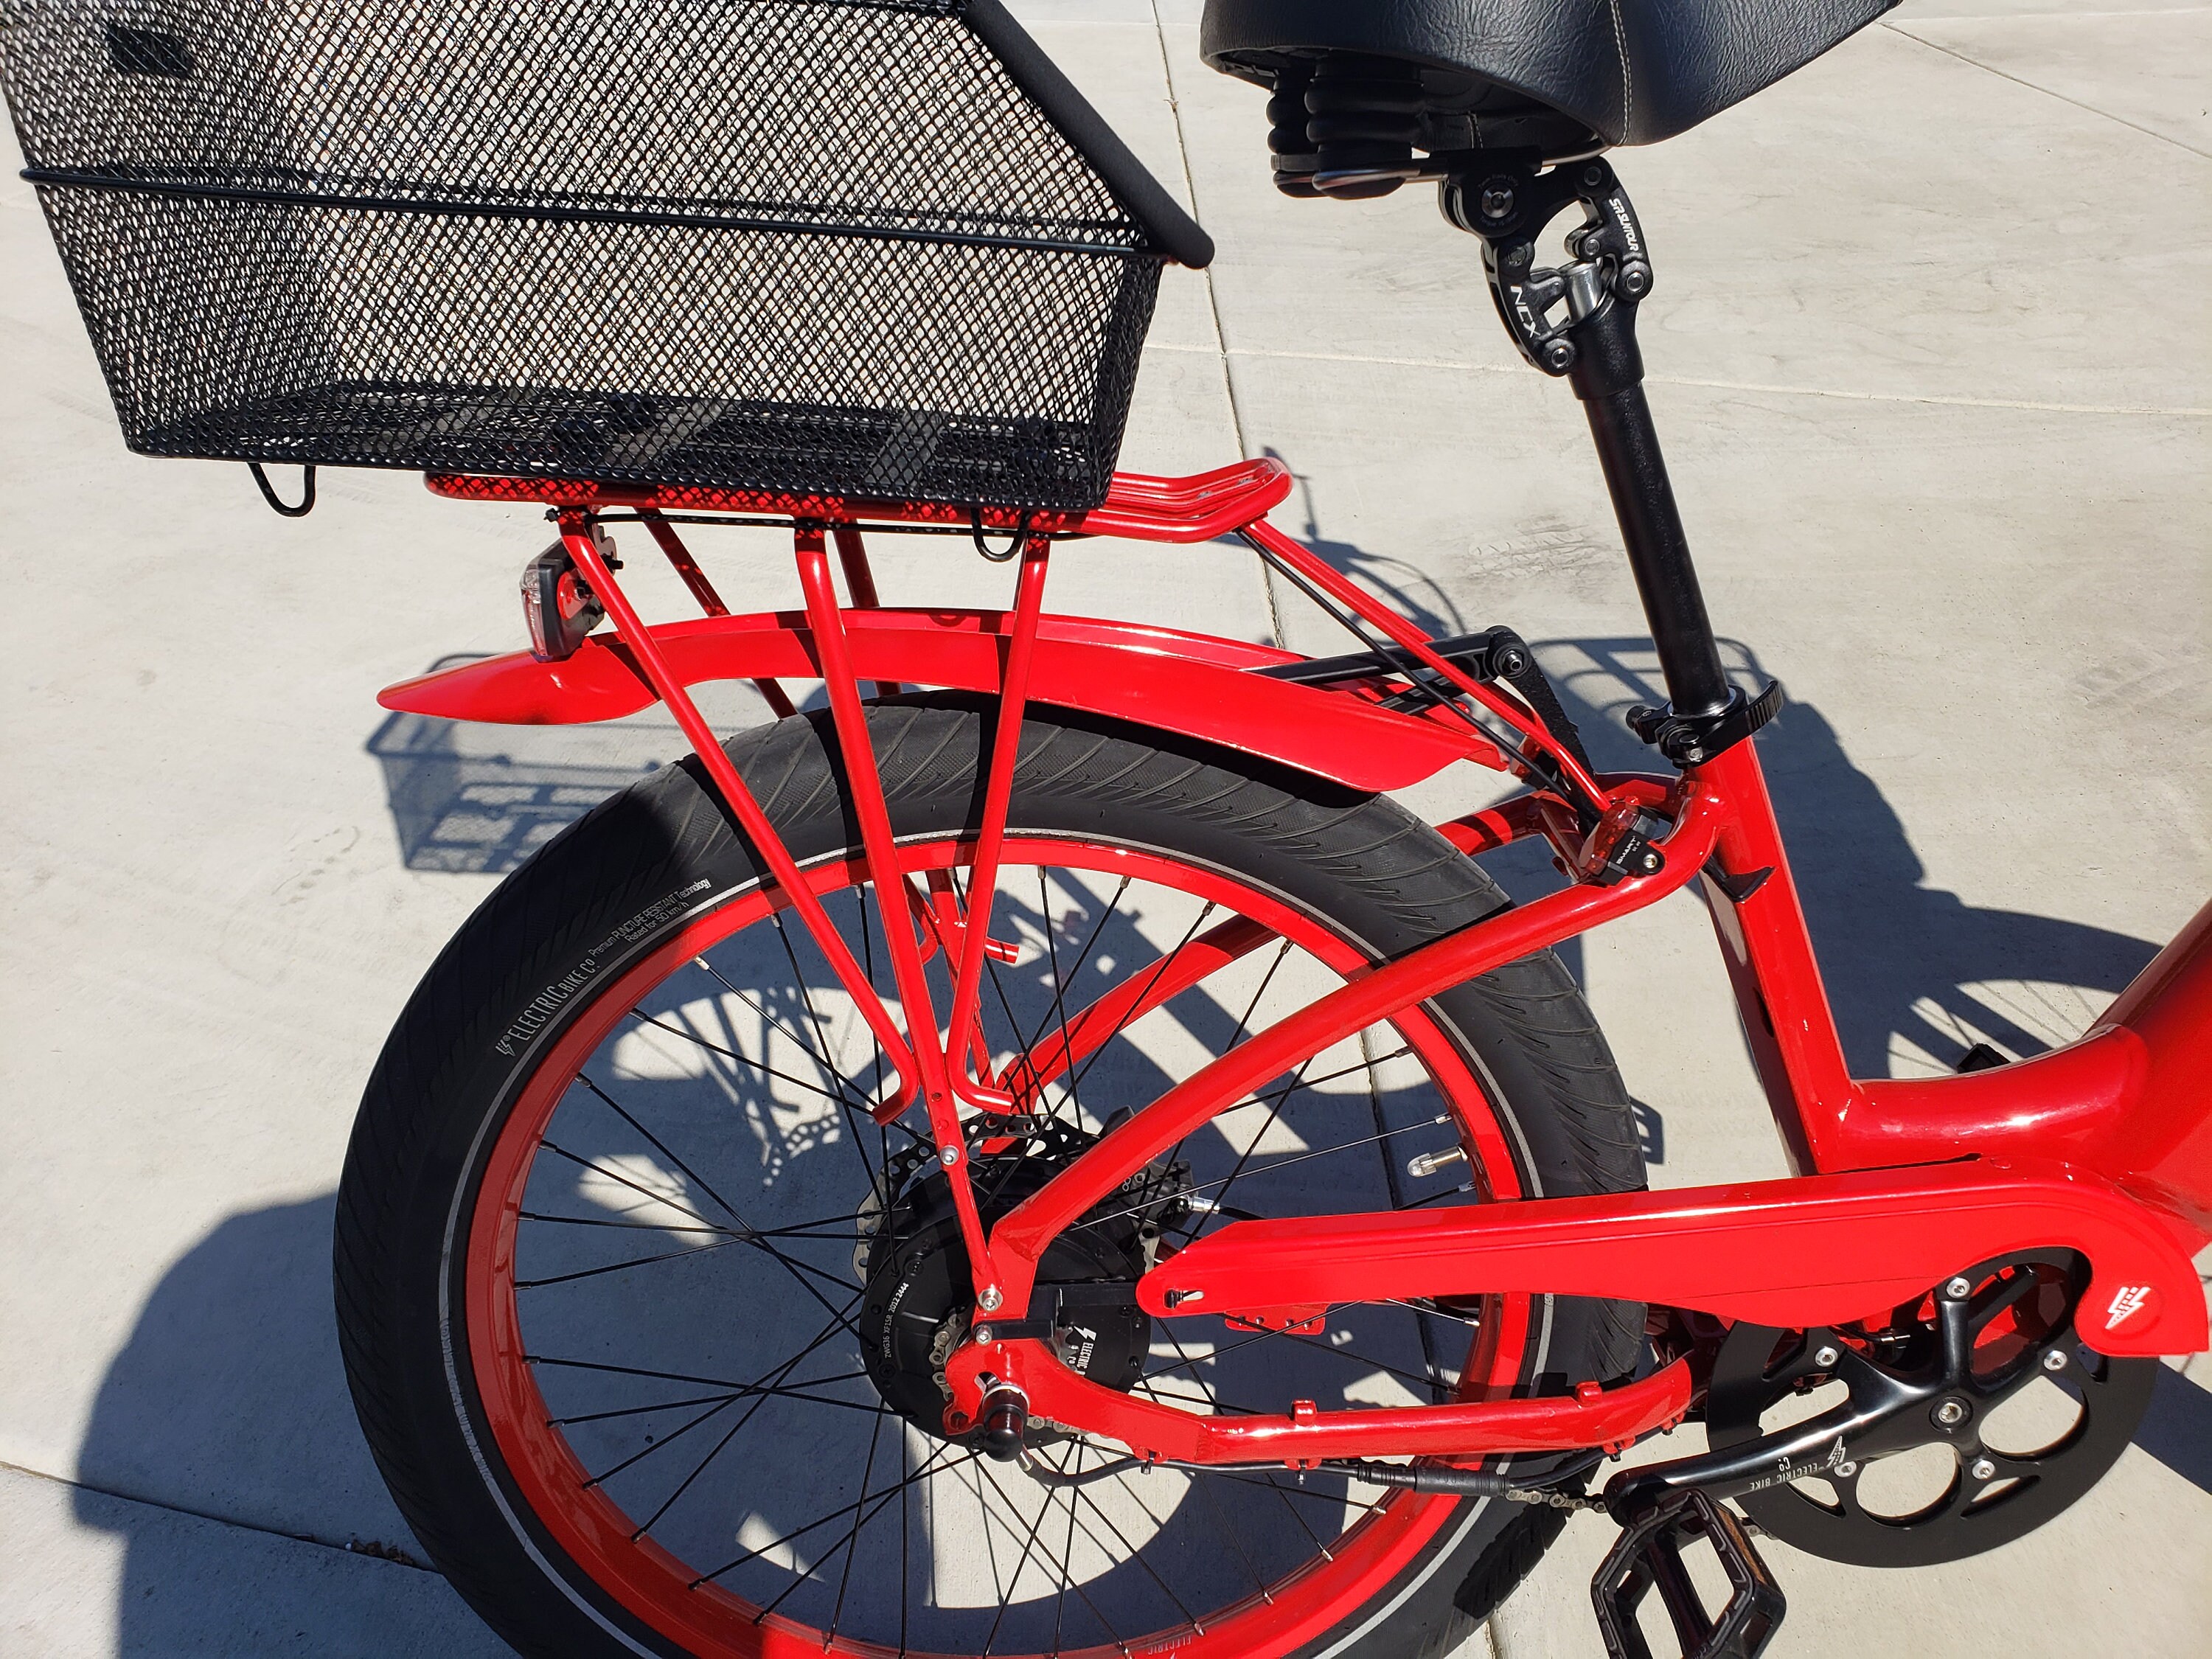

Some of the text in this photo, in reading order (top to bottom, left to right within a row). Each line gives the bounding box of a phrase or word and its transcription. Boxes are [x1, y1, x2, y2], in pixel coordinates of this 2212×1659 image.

[1617, 213, 1639, 251] SUNTOUR
[1511, 285, 1541, 338] NCX
[588, 936, 617, 957] Premium
[611, 913, 648, 940] PUNCTURE
[674, 878, 712, 900] Technology
[624, 927, 649, 943] Rated
[655, 913, 669, 922] 50
[668, 900, 690, 917] km/h
[507, 985, 568, 1041] ELECTRIC
[557, 969, 588, 992] BIKE
[1077, 1341, 1094, 1369] ELECTRIC
[1749, 1462, 1818, 1490] ELECTRIC BIKE
